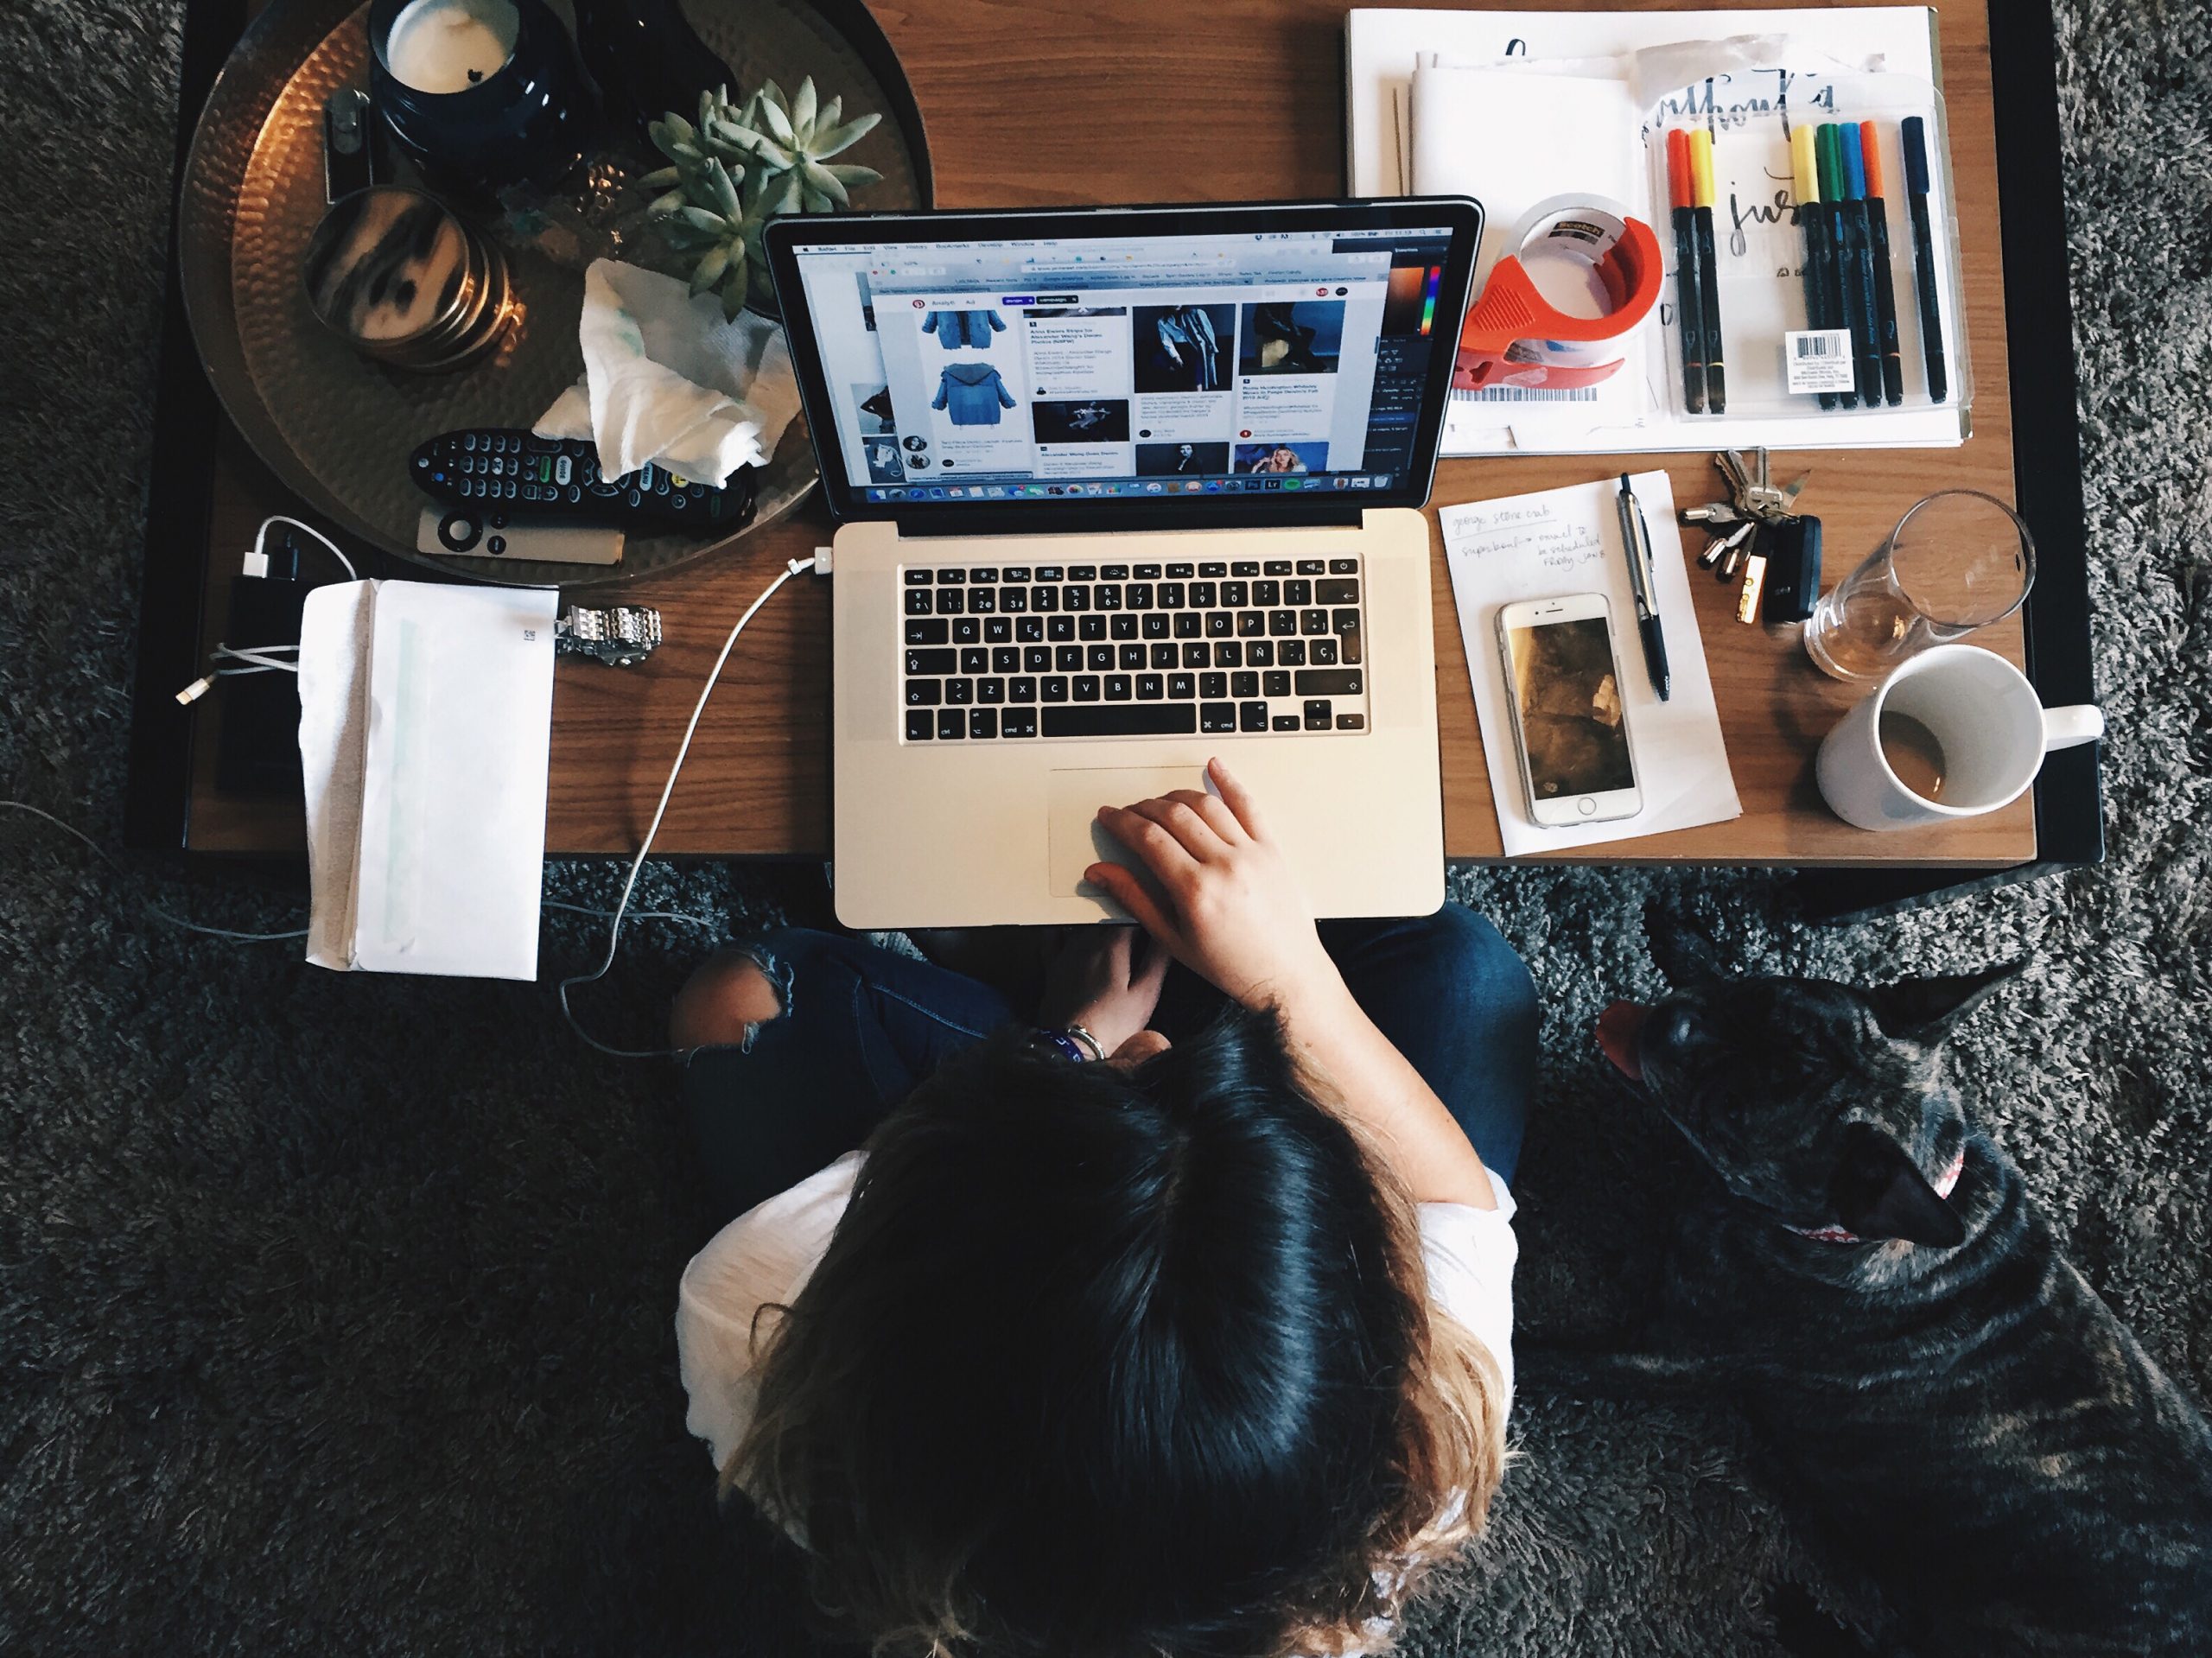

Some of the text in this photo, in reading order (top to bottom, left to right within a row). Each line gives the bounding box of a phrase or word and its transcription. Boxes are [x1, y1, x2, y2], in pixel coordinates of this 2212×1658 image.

[1558, 221, 1600, 235] Scotch
[1268, 480, 1278, 489] Lr
[1526, 505, 1551, 518] crab
[1256, 647, 1263, 657] Ñ
[1320, 648, 1326, 657] Ç
